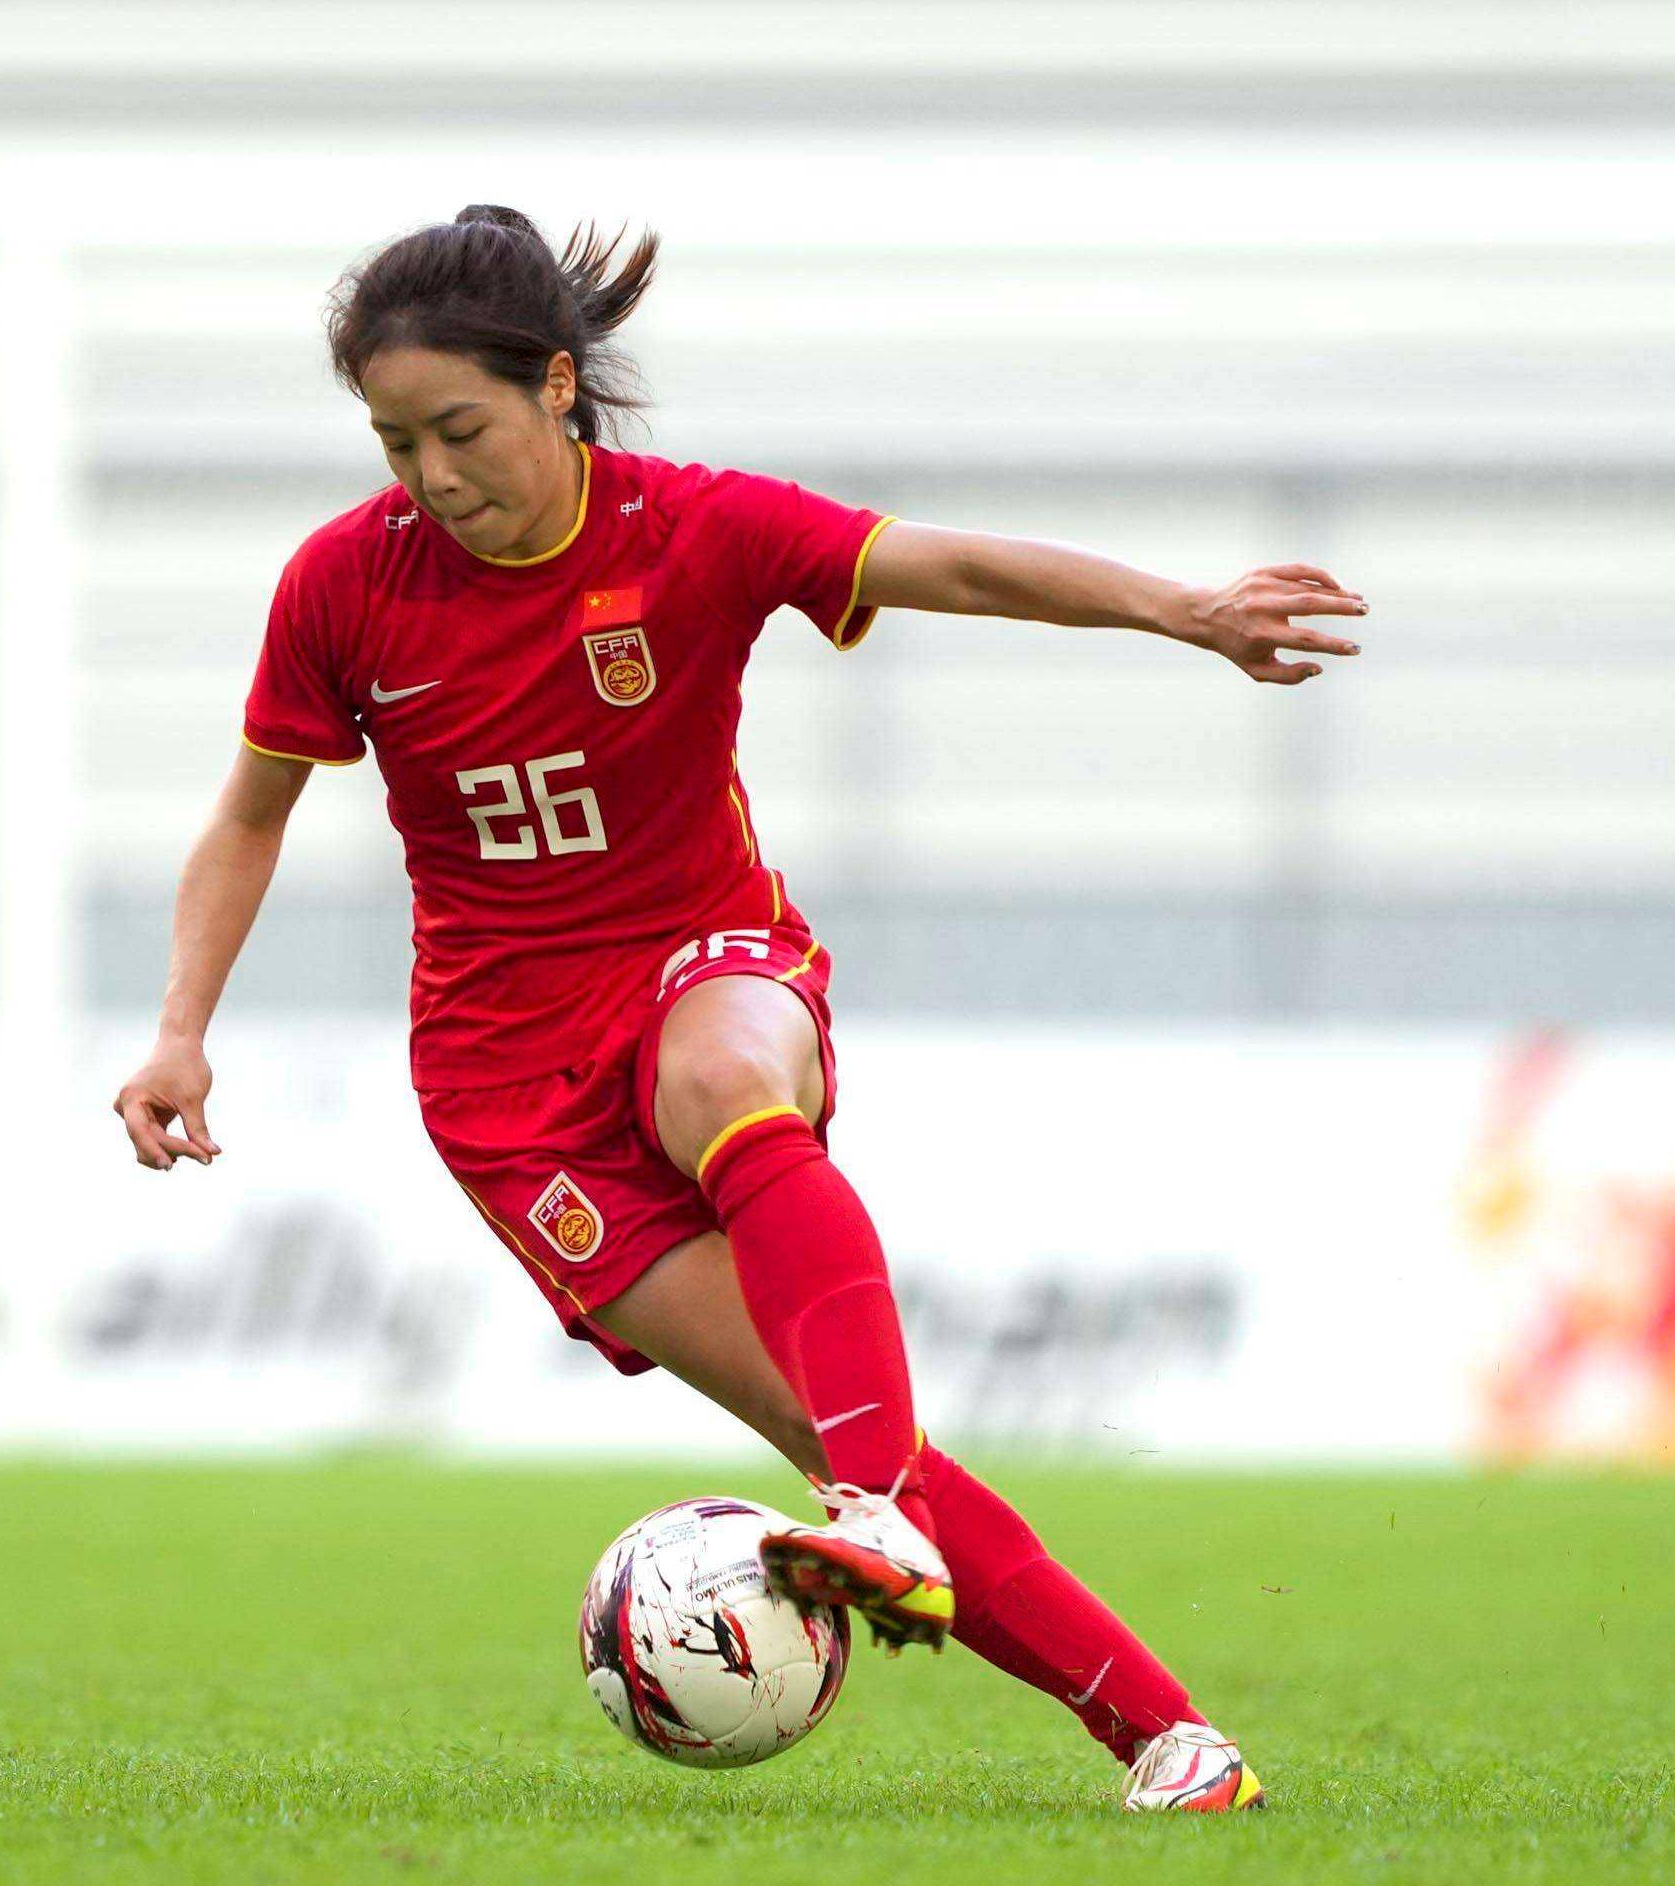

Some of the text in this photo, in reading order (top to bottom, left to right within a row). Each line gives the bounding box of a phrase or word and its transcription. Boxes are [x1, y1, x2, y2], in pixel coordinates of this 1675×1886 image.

[384, 508, 420, 531] CFA
[593, 635, 639, 655] CFA
[455, 750, 609, 861] 26
[537, 1184, 570, 1224] CFA
